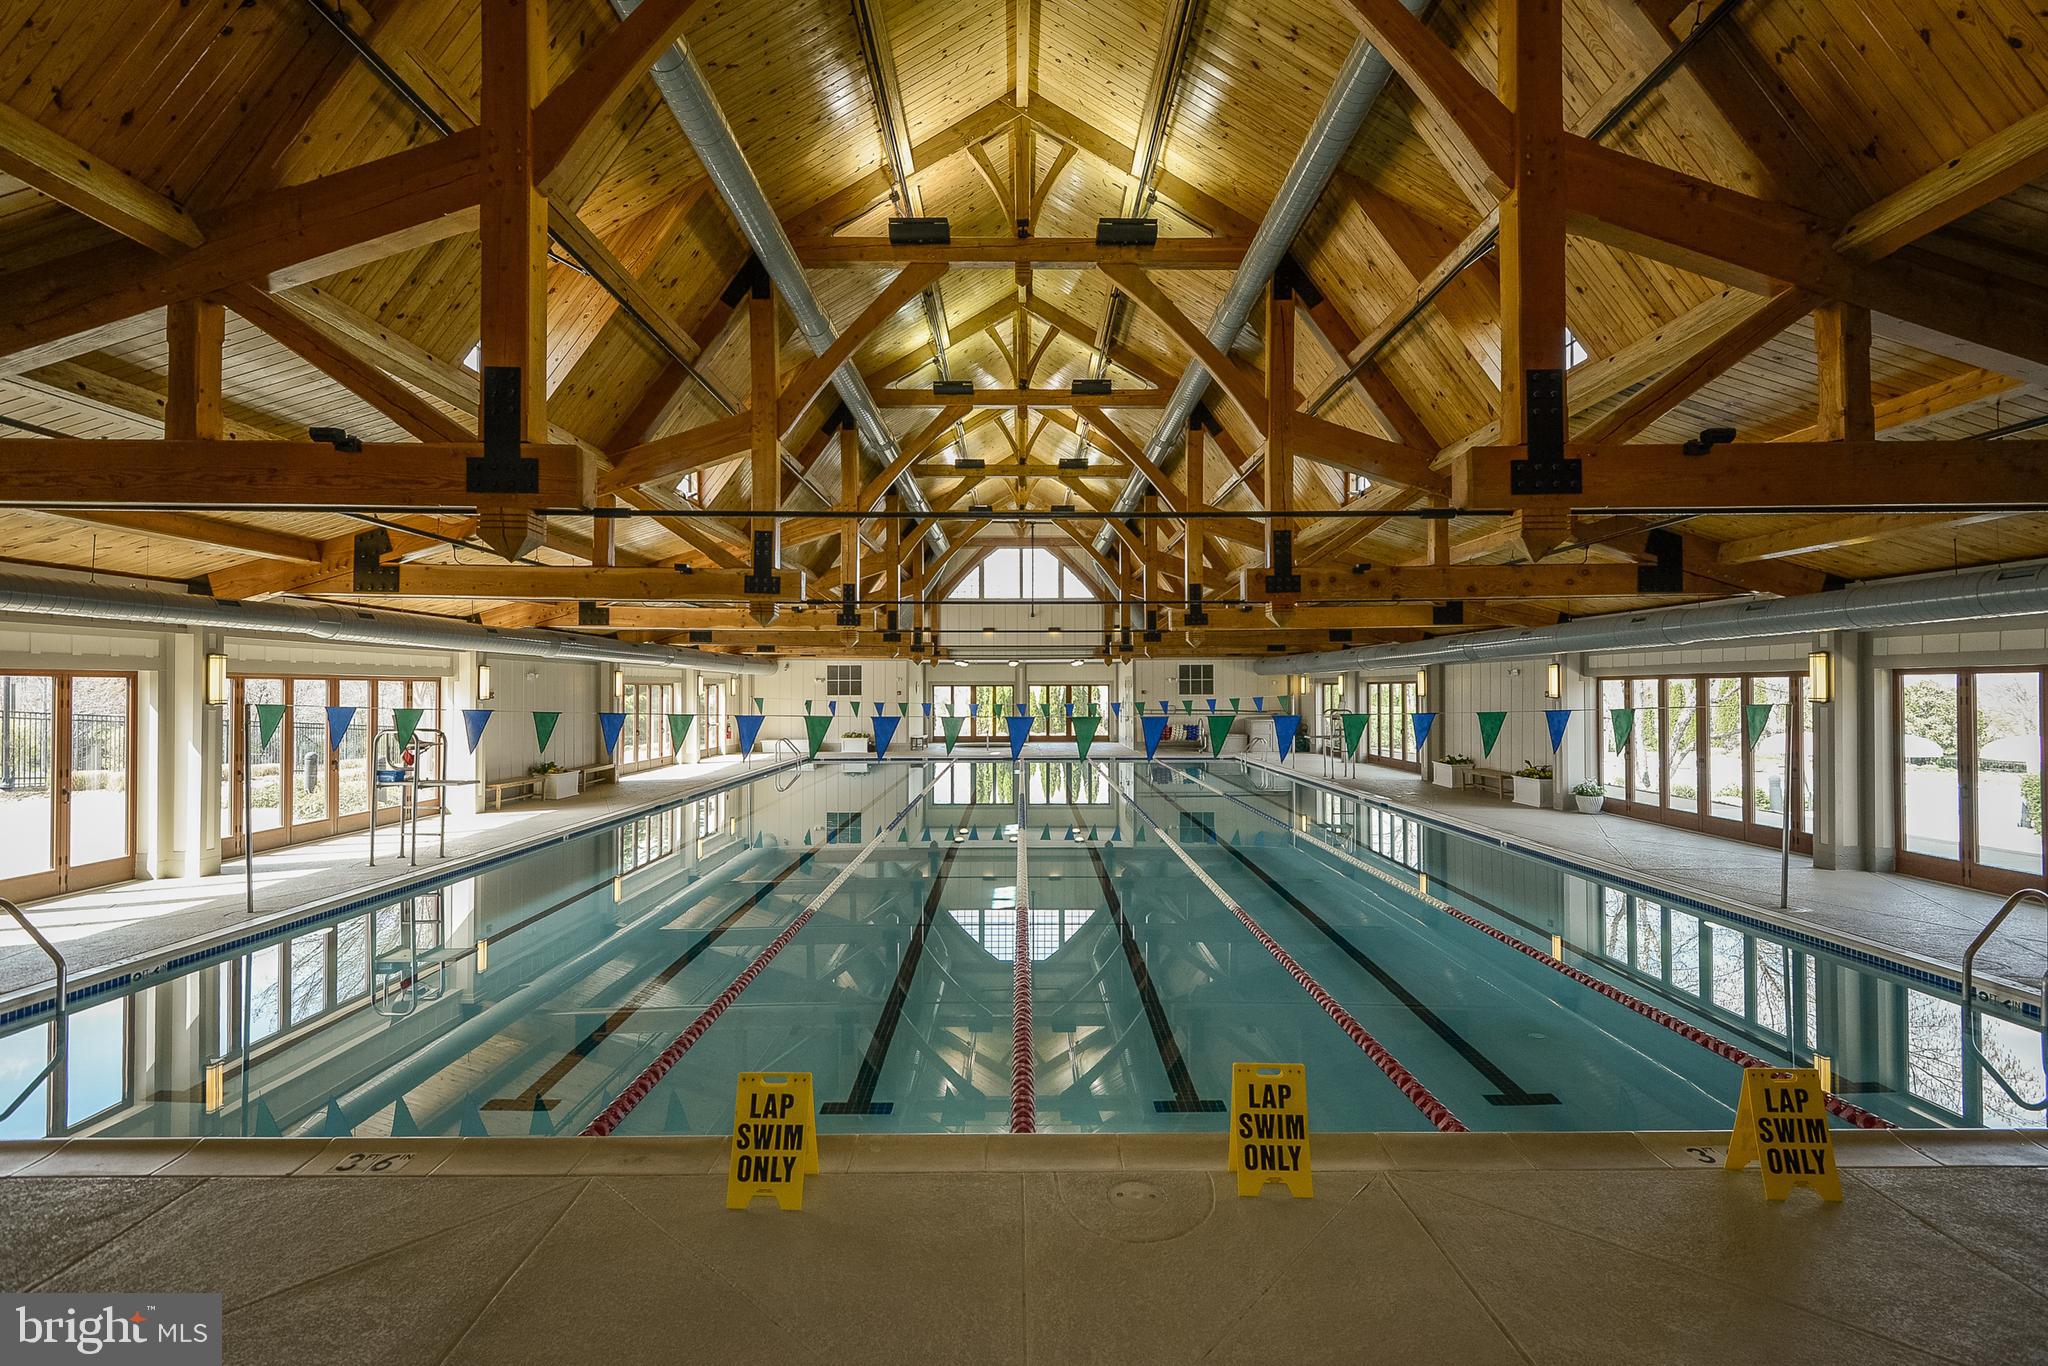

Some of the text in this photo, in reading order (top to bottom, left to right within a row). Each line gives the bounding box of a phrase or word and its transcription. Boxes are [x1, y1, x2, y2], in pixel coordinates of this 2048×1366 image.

[749, 1093, 795, 1119] LAP
[1248, 1083, 1292, 1109] LAP
[1763, 1087, 1809, 1113] LAP
[736, 1123, 804, 1150] SWIM
[1239, 1112, 1305, 1140] SWIM
[1758, 1117, 1828, 1143] SWIM
[736, 1154, 797, 1183] ONLY
[1244, 1143, 1302, 1171] ONLY
[1766, 1148, 1825, 1175] ONLY
